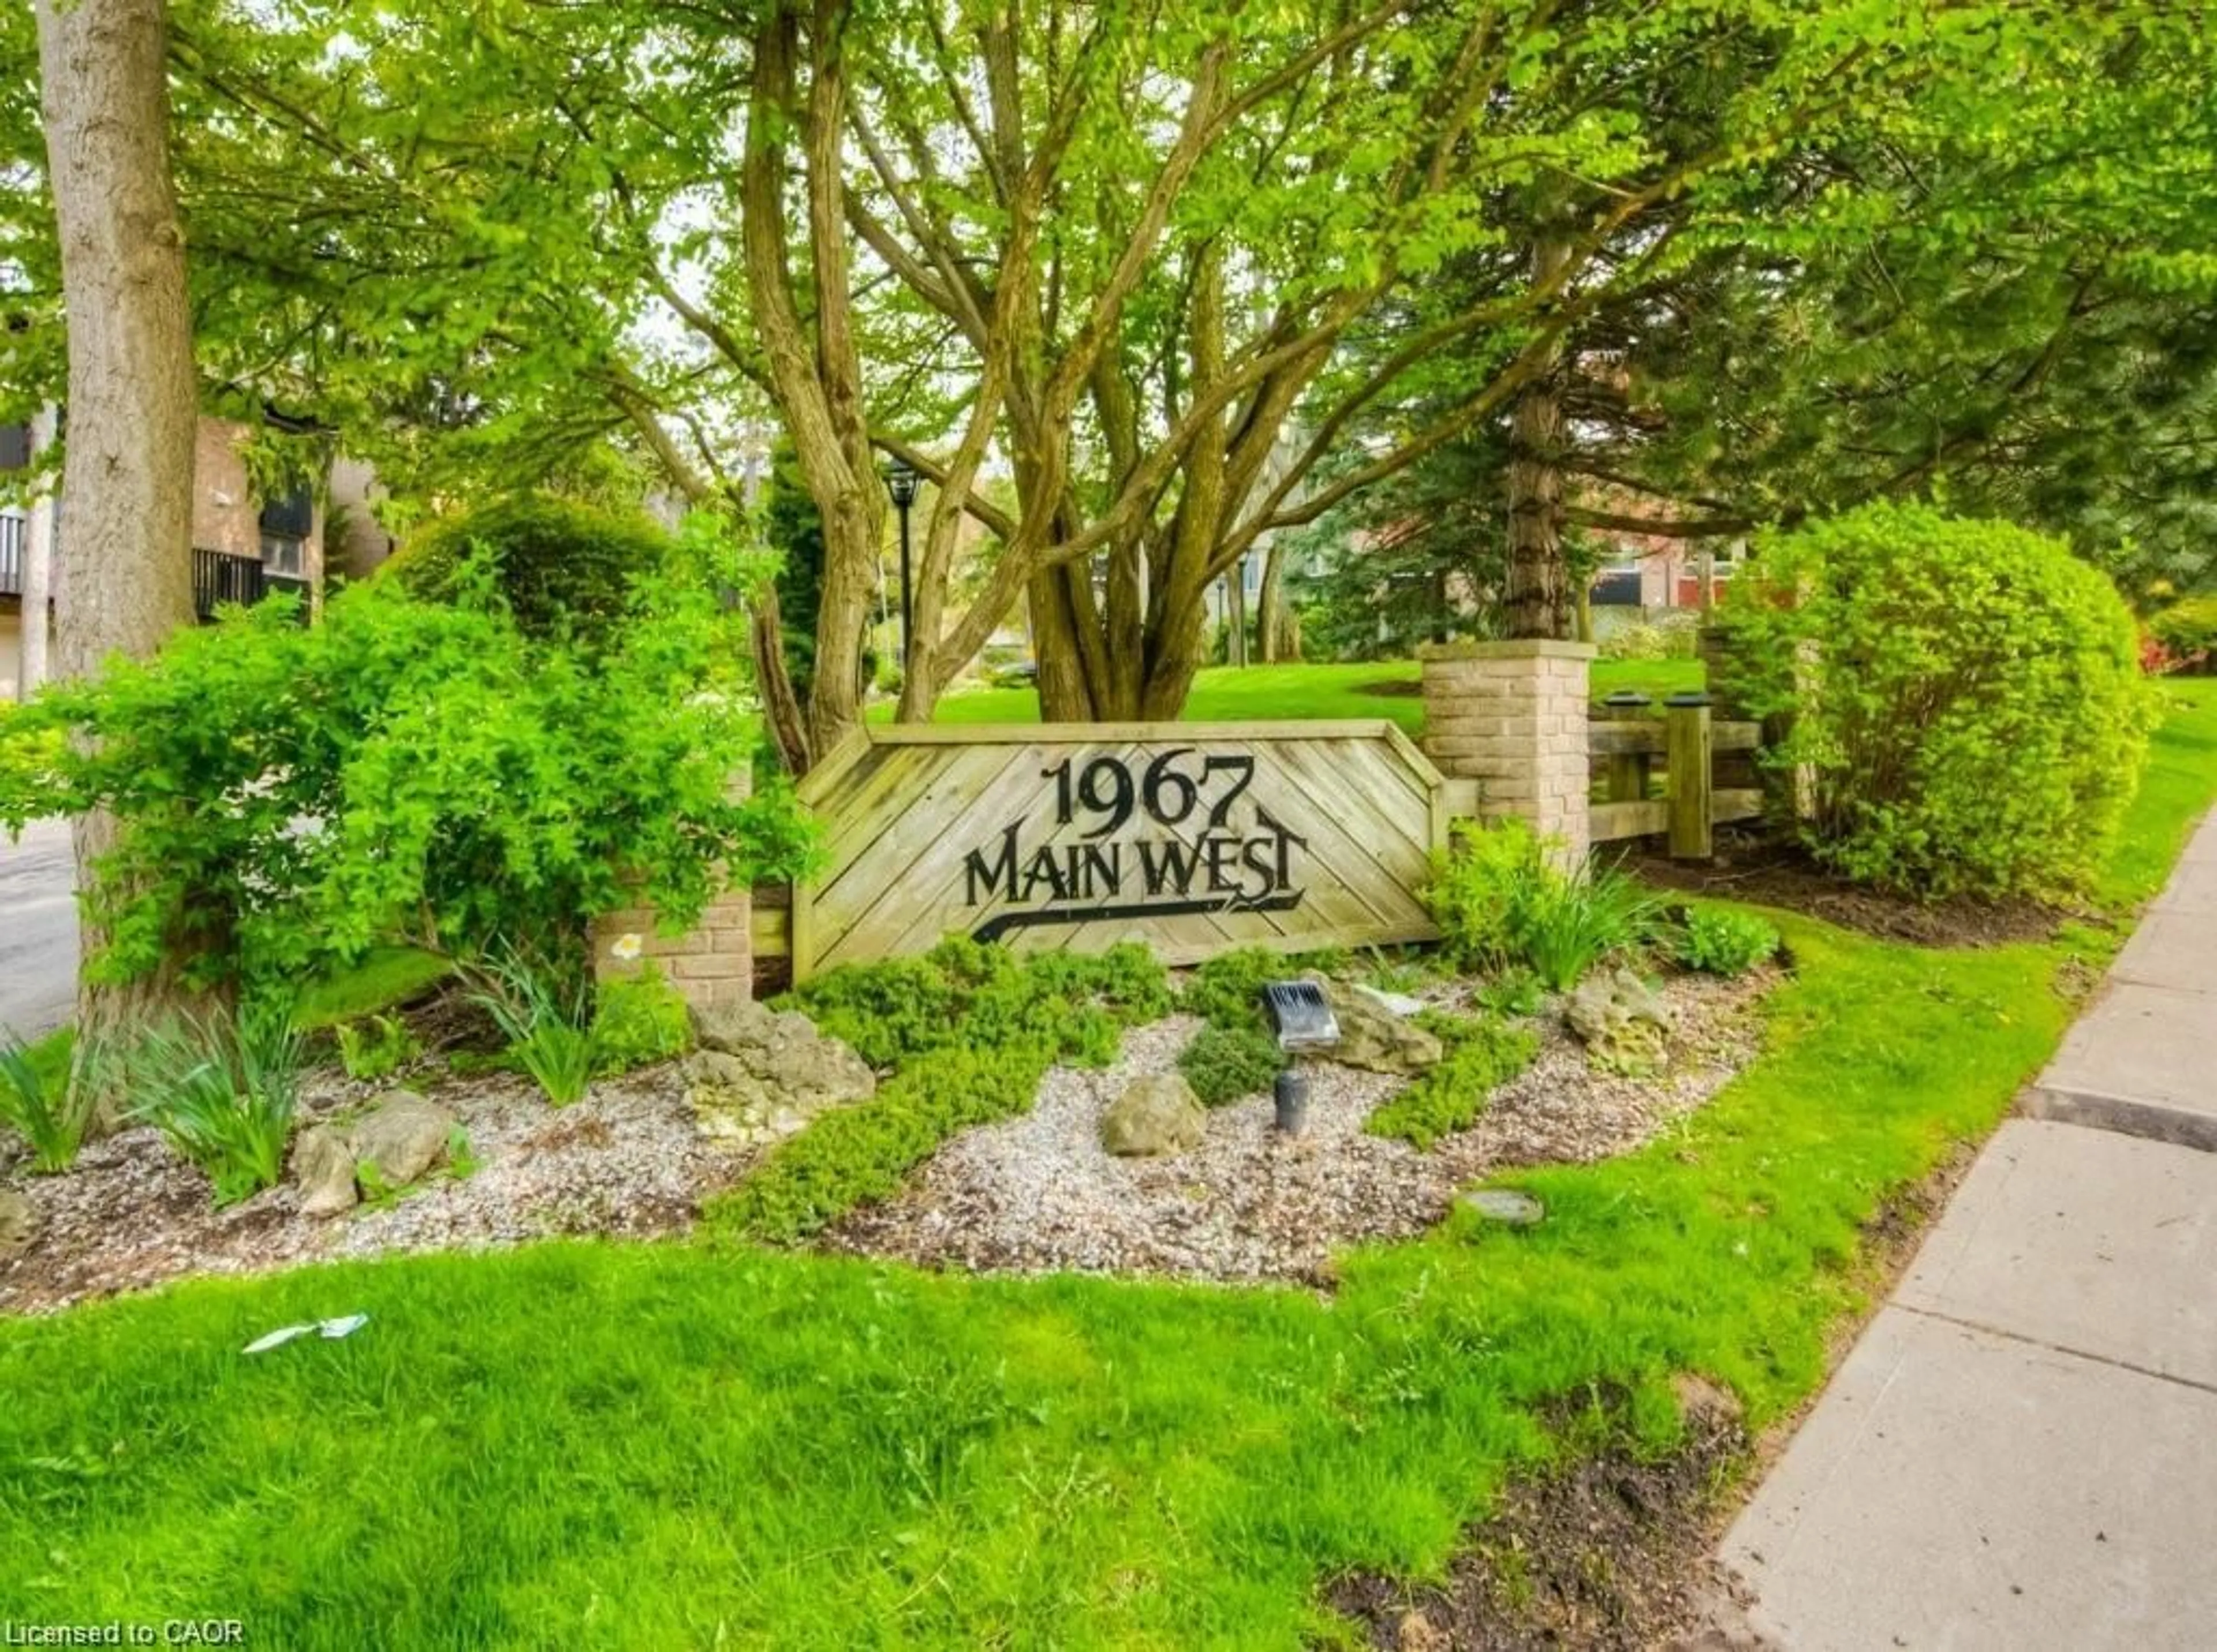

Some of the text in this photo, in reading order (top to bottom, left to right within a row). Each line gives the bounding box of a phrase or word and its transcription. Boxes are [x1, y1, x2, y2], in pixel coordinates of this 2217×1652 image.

[1042, 748, 1254, 838] 1967
[964, 806, 1307, 906] MAIN WEST
